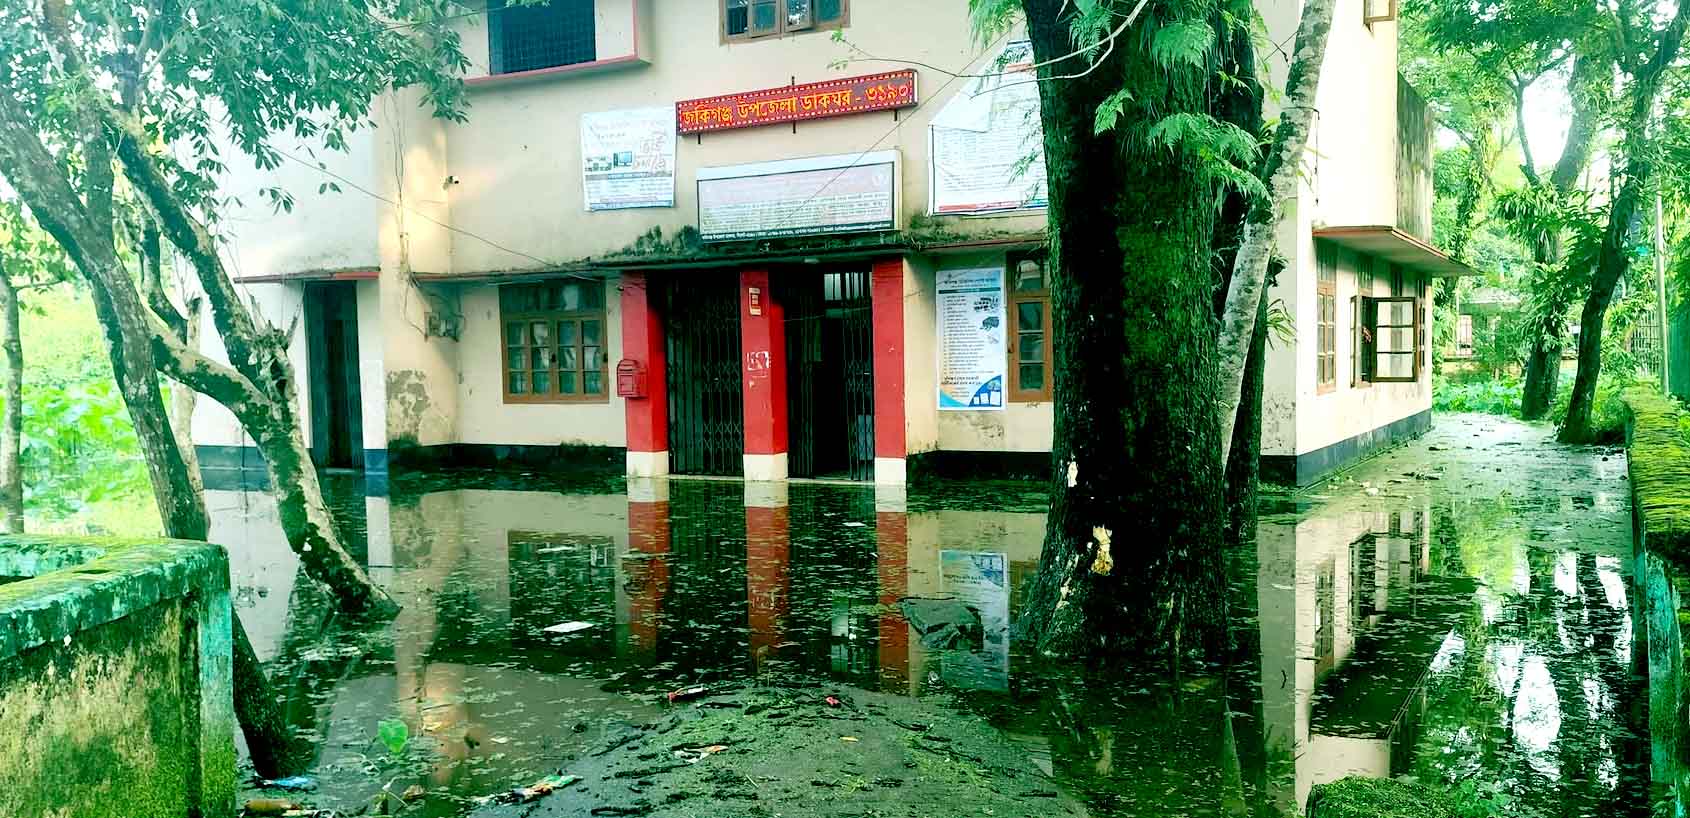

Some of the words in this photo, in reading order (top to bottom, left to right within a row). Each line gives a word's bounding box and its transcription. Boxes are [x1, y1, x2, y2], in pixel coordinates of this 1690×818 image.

[737, 95, 797, 118] উপজেলা
[800, 89, 853, 110] ডাকঘর
[865, 83, 908, 101] ৩১৯০
